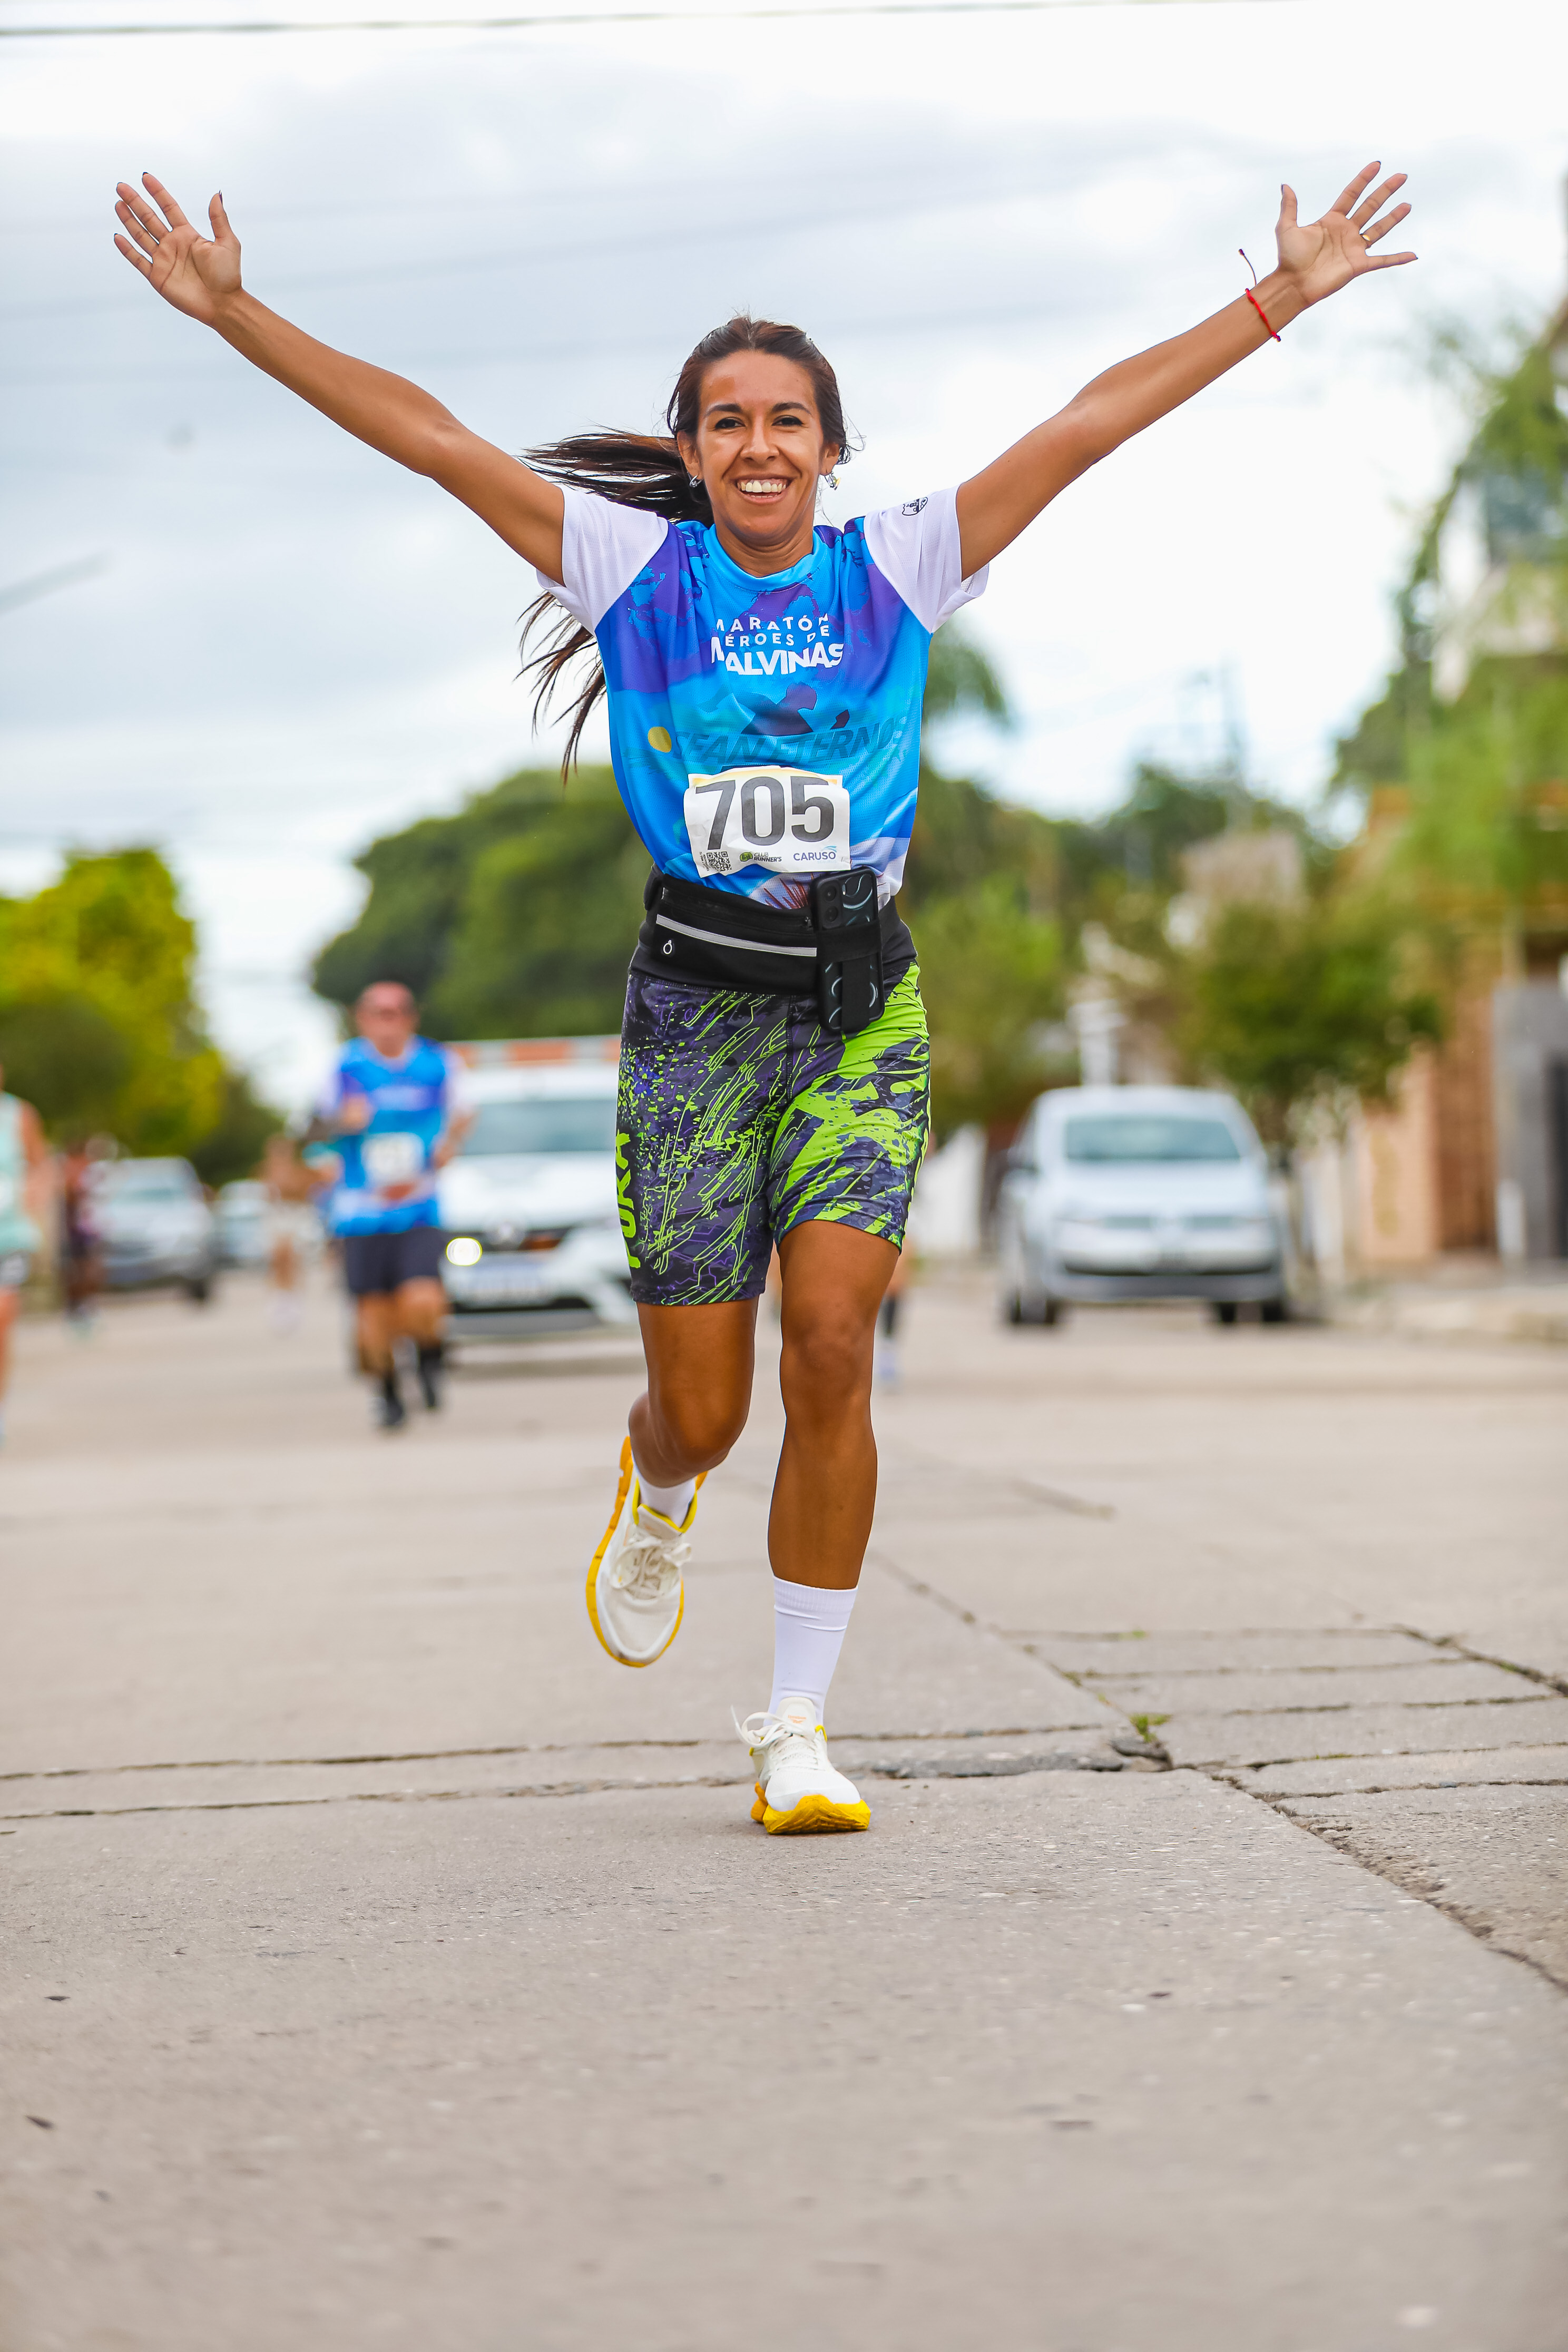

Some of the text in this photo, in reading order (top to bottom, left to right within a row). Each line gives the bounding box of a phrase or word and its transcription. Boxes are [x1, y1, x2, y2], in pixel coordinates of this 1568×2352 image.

[725, 625, 830, 647] ÉROES DE
[695, 776, 835, 850] 705
[793, 851, 836, 861] CARUSO
